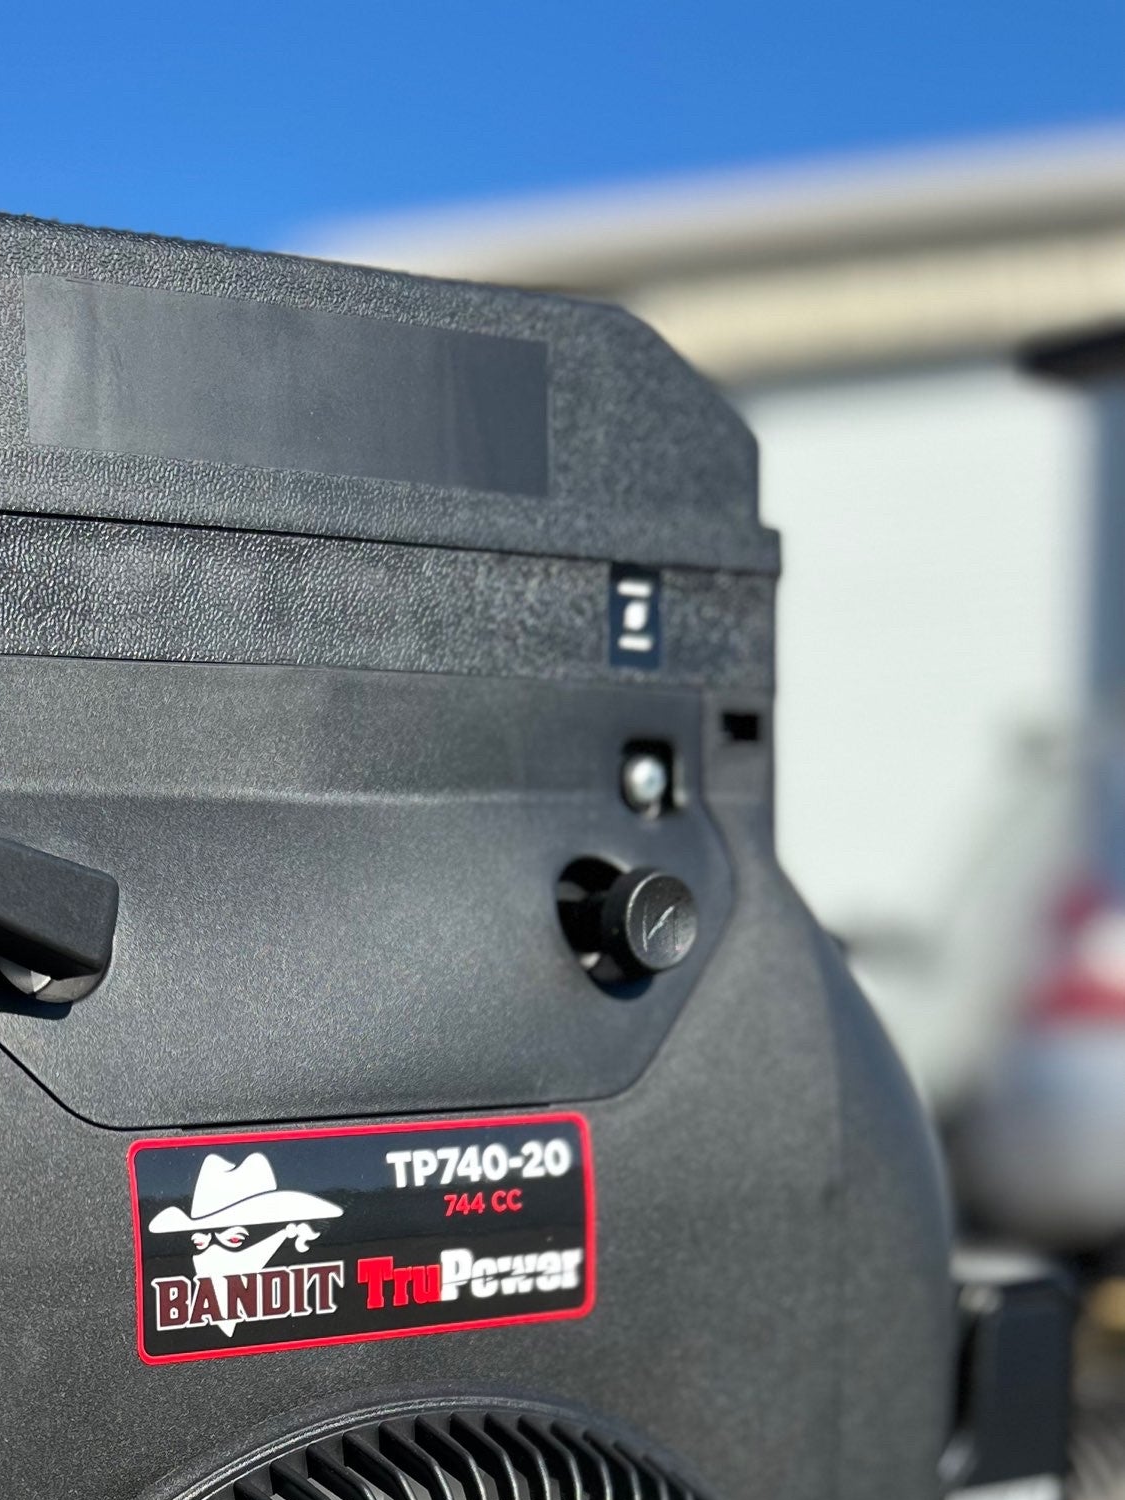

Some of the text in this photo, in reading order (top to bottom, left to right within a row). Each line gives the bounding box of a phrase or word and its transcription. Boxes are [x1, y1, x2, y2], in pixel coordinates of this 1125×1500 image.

[386, 1138, 572, 1188] TP740-20
[443, 1188, 523, 1217] 744 CC
[151, 1260, 345, 1331] BANDIT
[357, 1248, 583, 1310] TruPower
